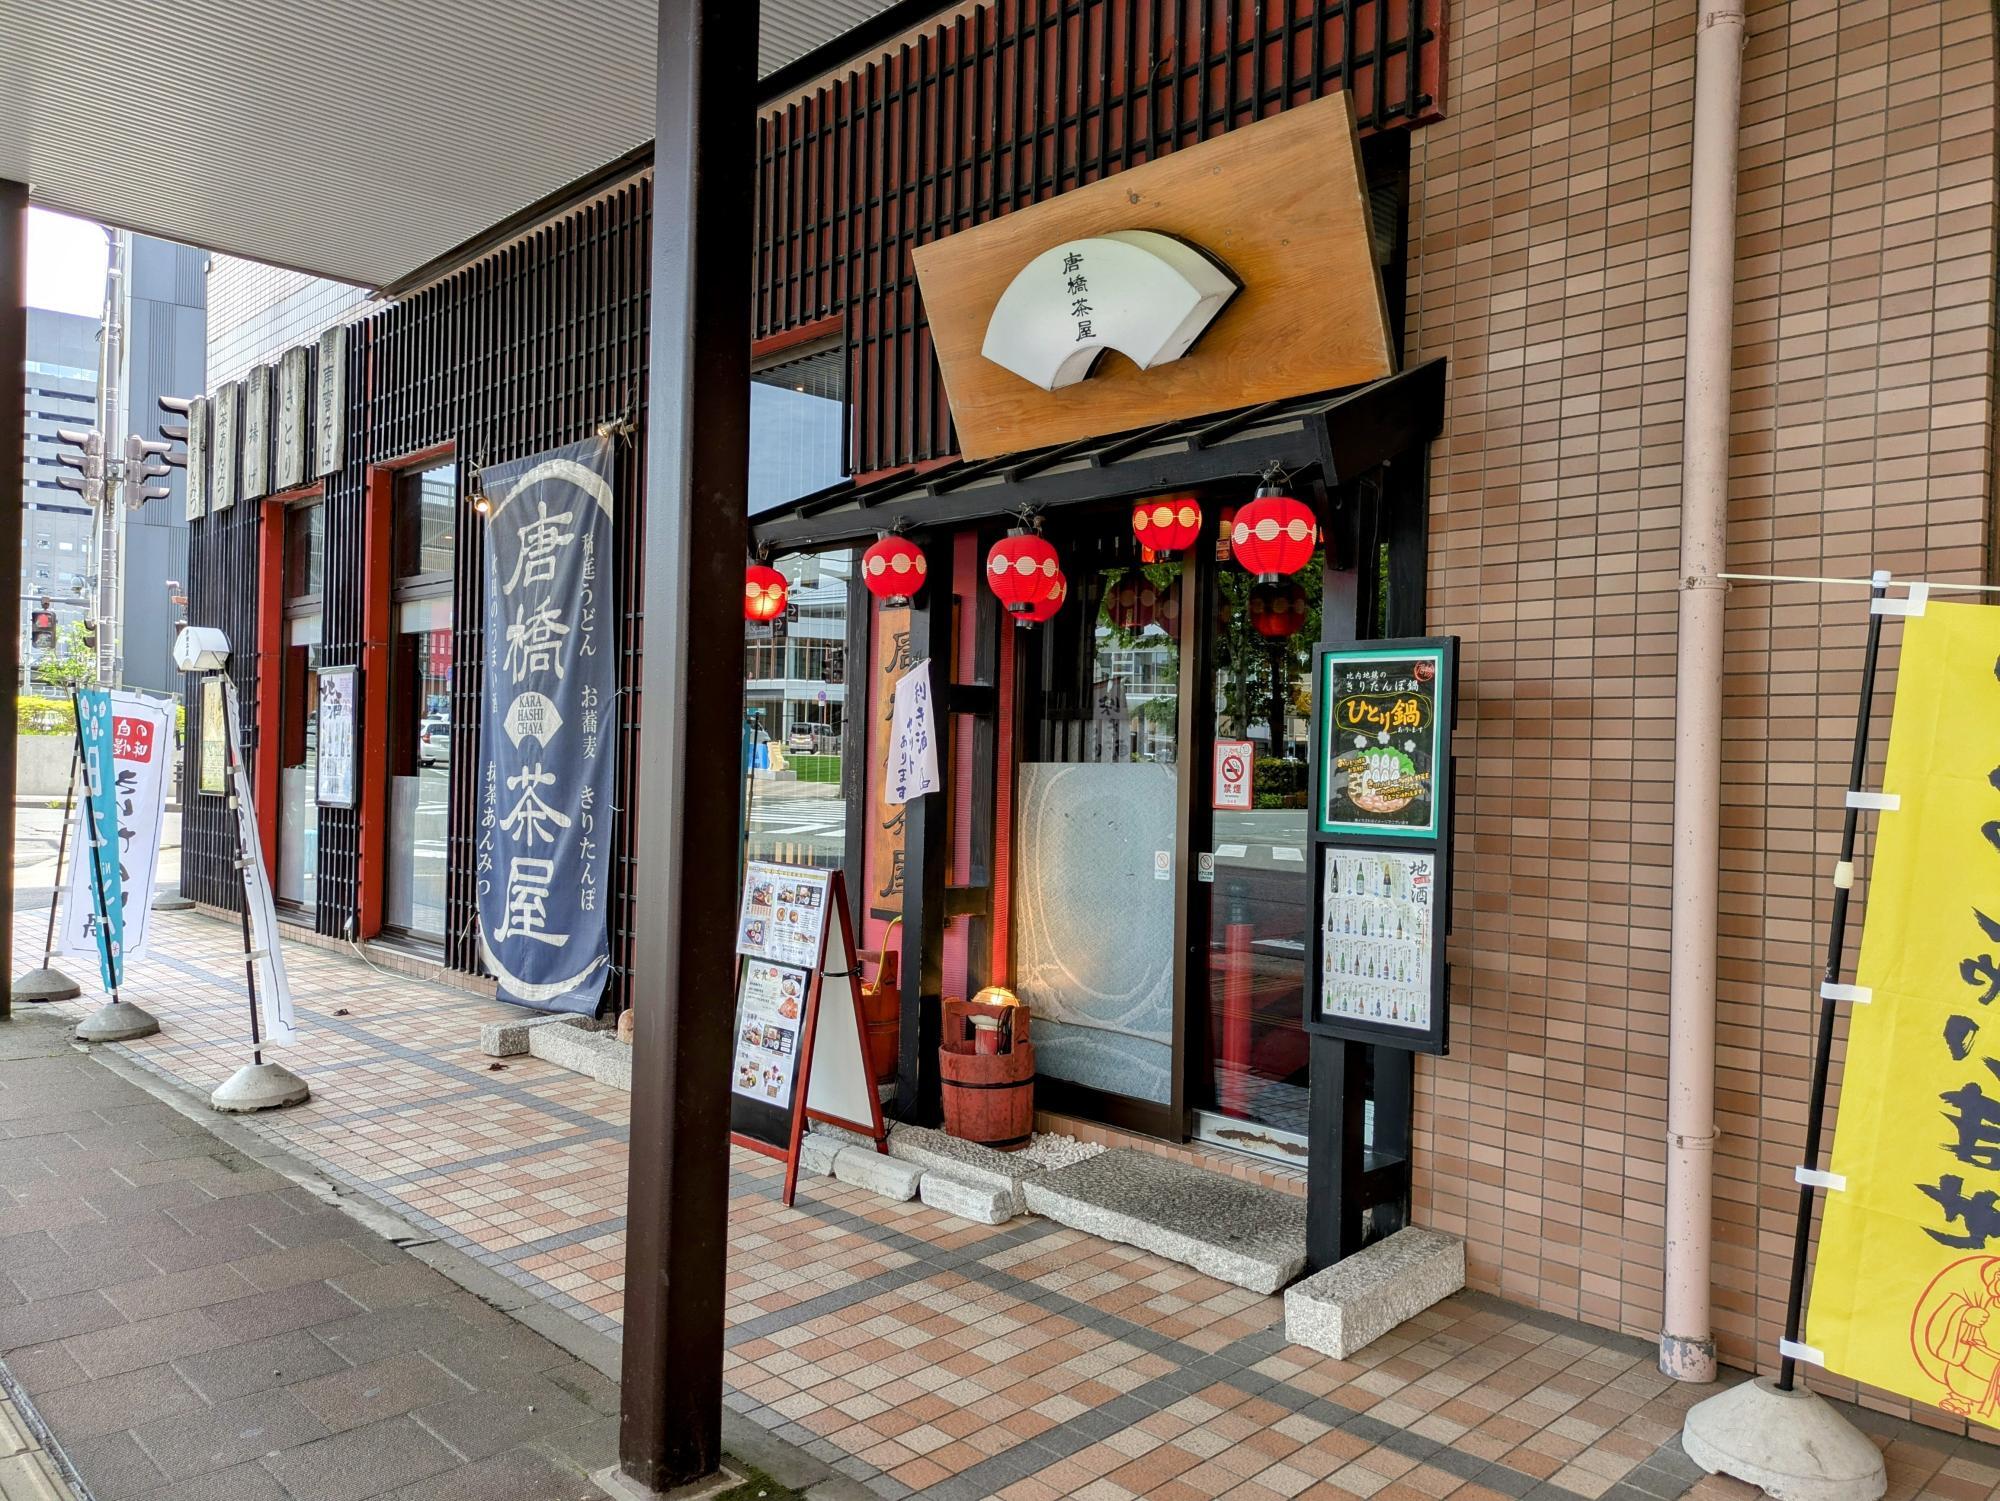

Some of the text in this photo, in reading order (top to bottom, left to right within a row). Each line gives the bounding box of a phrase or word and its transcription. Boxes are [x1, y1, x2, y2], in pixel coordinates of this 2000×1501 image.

[1062, 252, 1097, 342] 唐橋茶屋
[1345, 679, 1419, 693] きりたんぽ鍋
[518, 695, 542, 708] KARA
[517, 708, 544, 722] HASHI
[580, 533, 598, 911] 稲庭うどん お蕎麦 きりたんぽ
[1348, 699, 1421, 732] ひとり鍋
[517, 721, 544, 735] CHAYA
[895, 734, 908, 800] あります
[1223, 784, 1241, 794] 禁煙
[1409, 859, 1431, 905] 地酒
